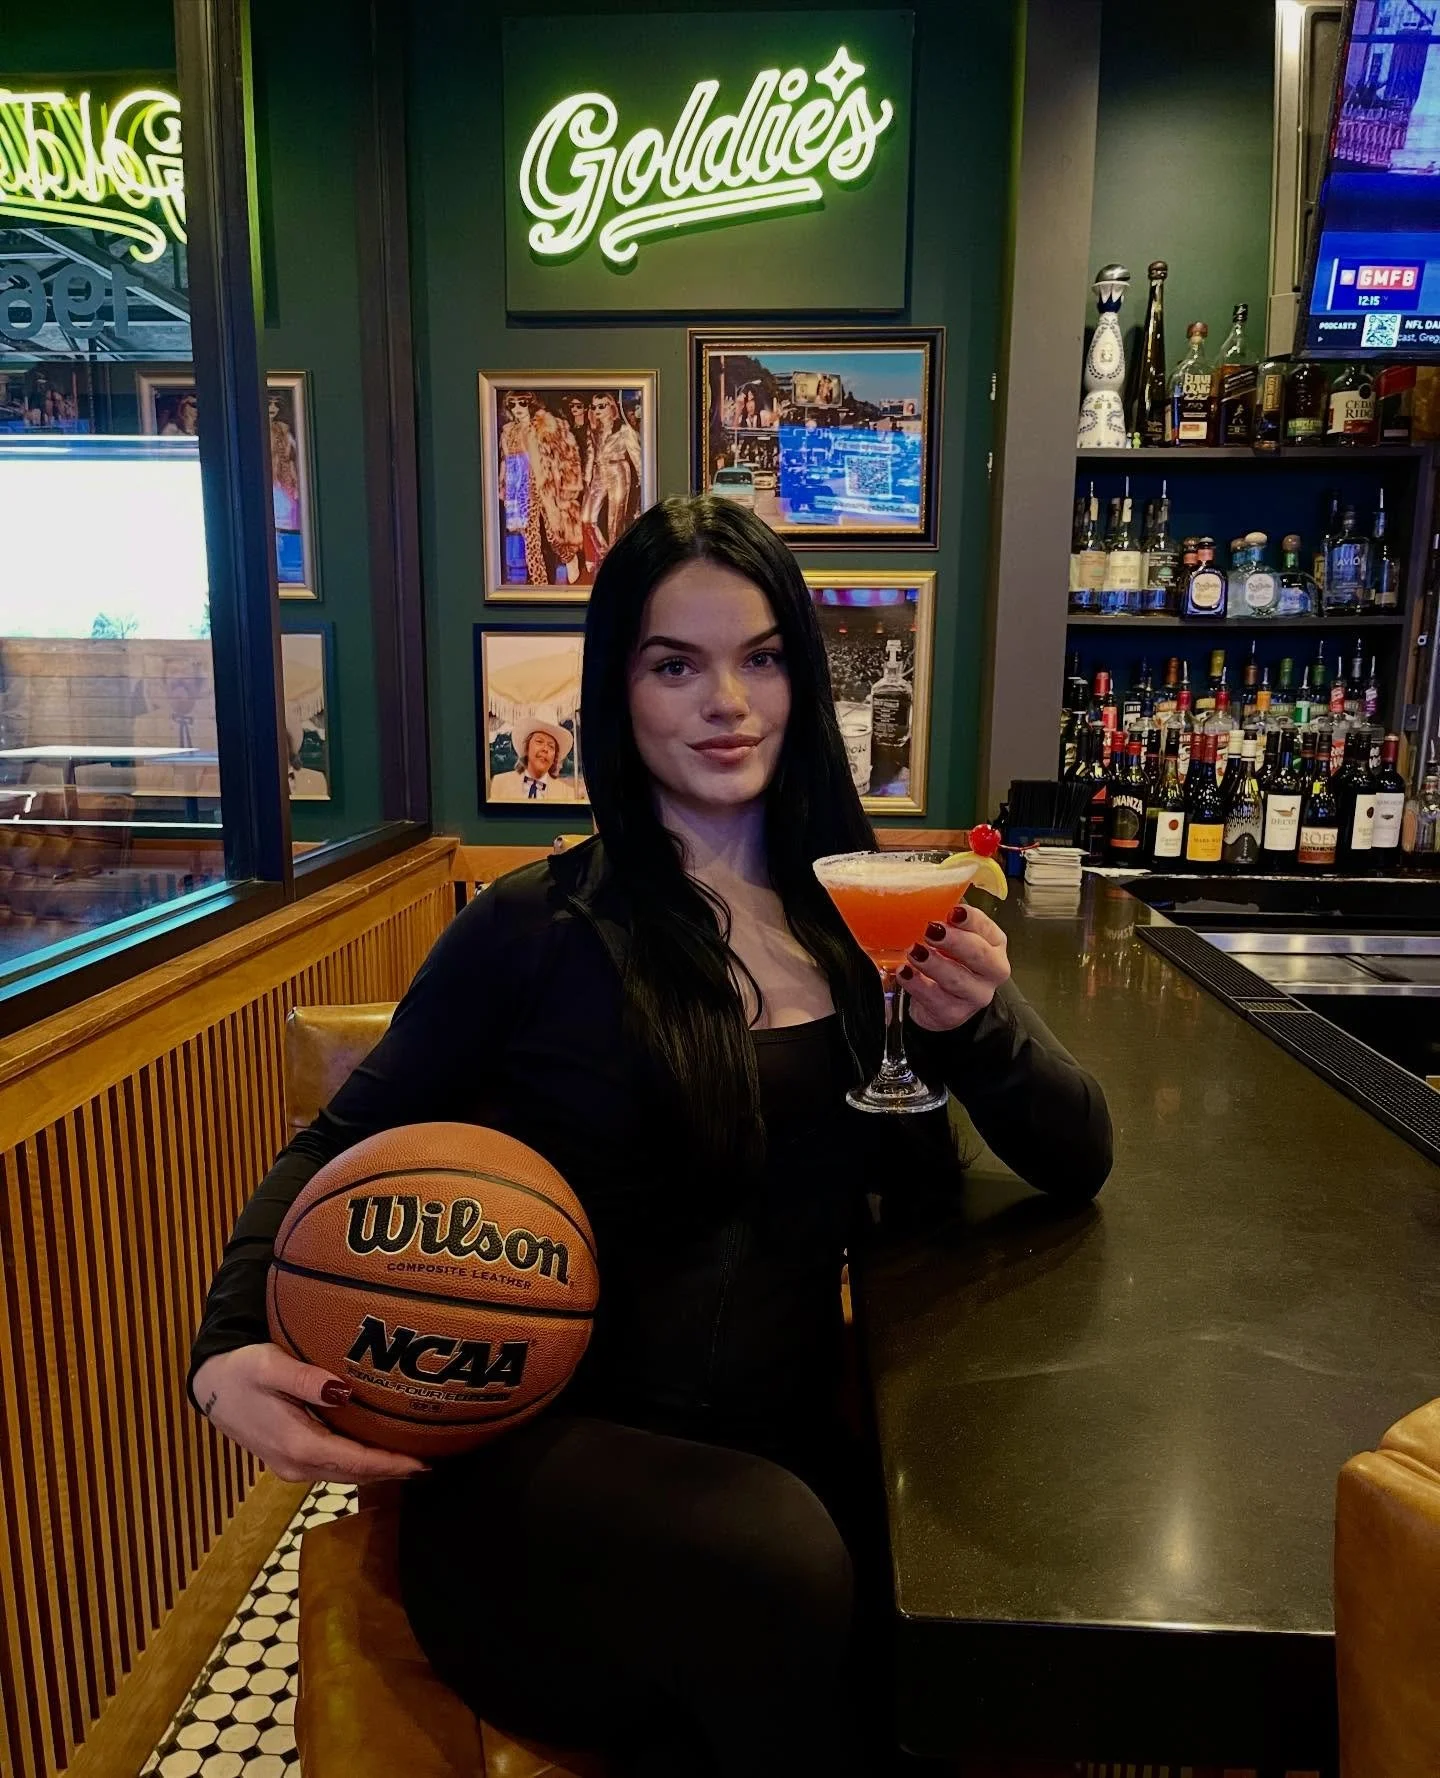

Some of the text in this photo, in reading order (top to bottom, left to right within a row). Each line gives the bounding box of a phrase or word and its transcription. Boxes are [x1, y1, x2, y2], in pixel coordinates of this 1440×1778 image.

[1360, 269, 1415, 287] GMFB
[1319, 322, 1357, 330] PODCASTS
[1405, 320, 1423, 330] NFL
[346, 1195, 570, 1286] Wilson
[387, 1262, 532, 1289] COMPOSITE LEATHER
[344, 1314, 529, 1390] NCAA
